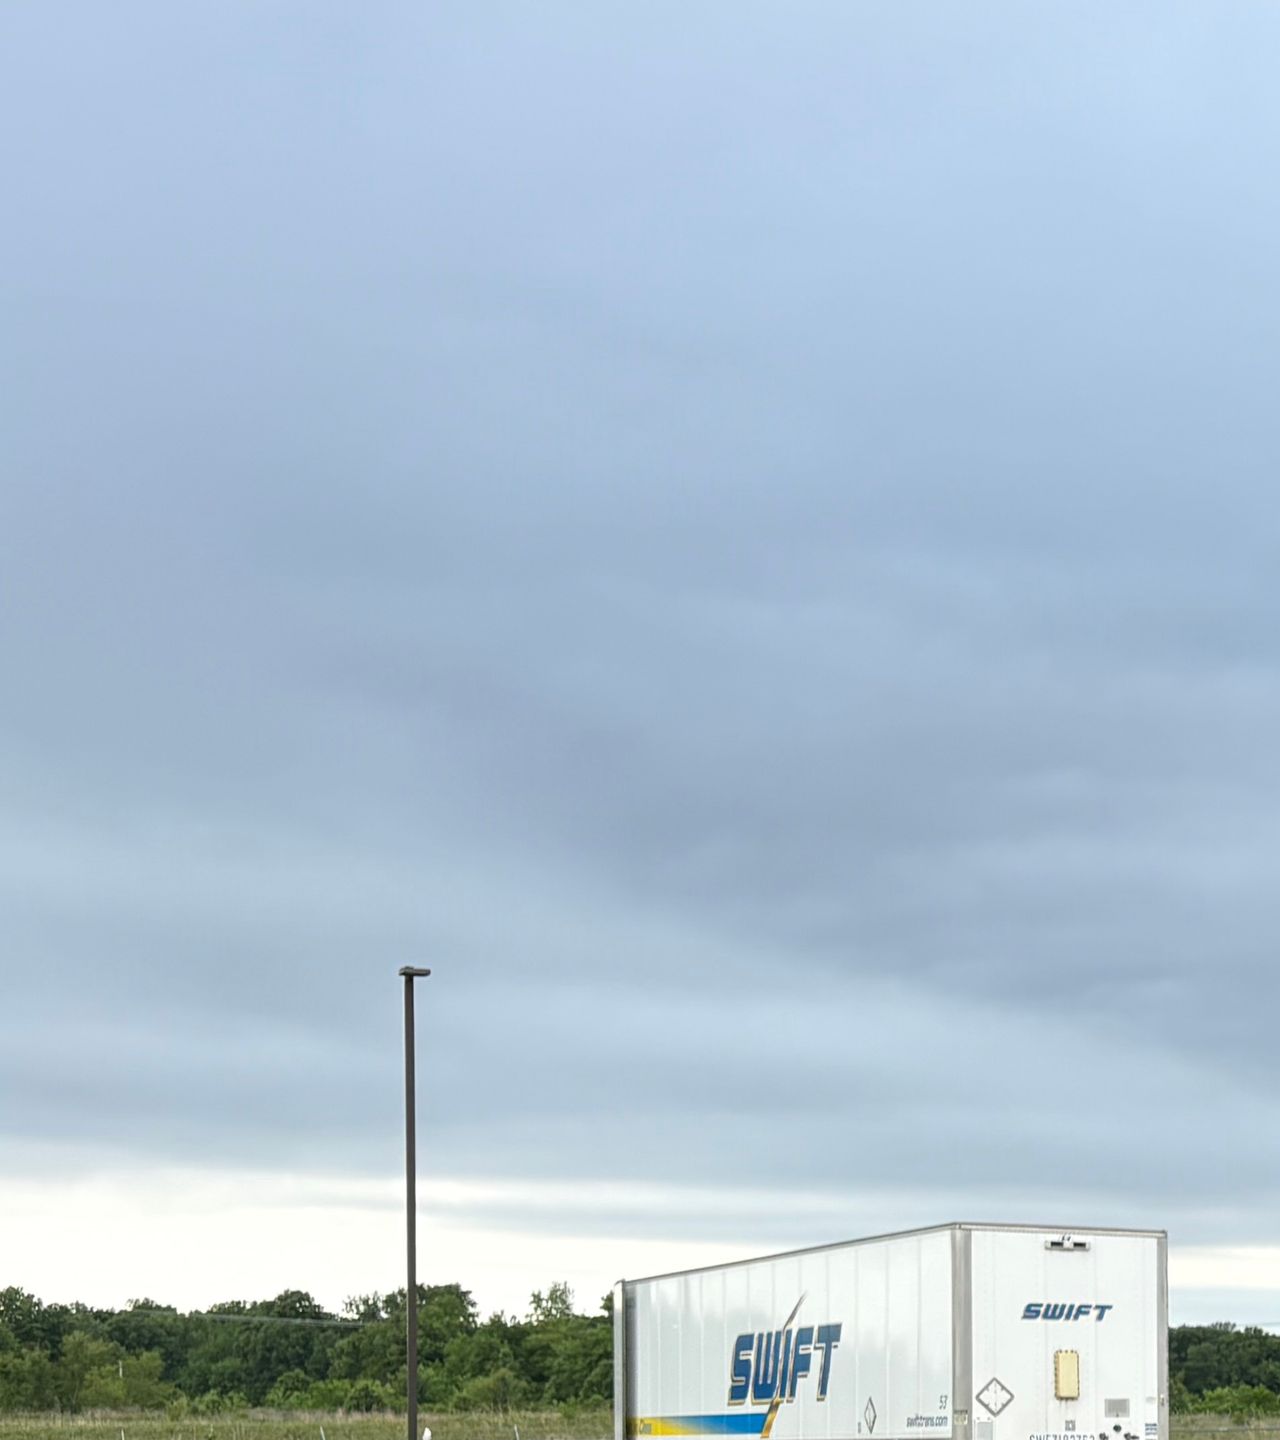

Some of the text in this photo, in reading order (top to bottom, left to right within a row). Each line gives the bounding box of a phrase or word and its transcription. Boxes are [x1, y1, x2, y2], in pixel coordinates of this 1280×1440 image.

[1021, 1303, 1113, 1321] SWIFT
[728, 1323, 843, 1407] SWIFT
[939, 1394, 948, 1411] 53
